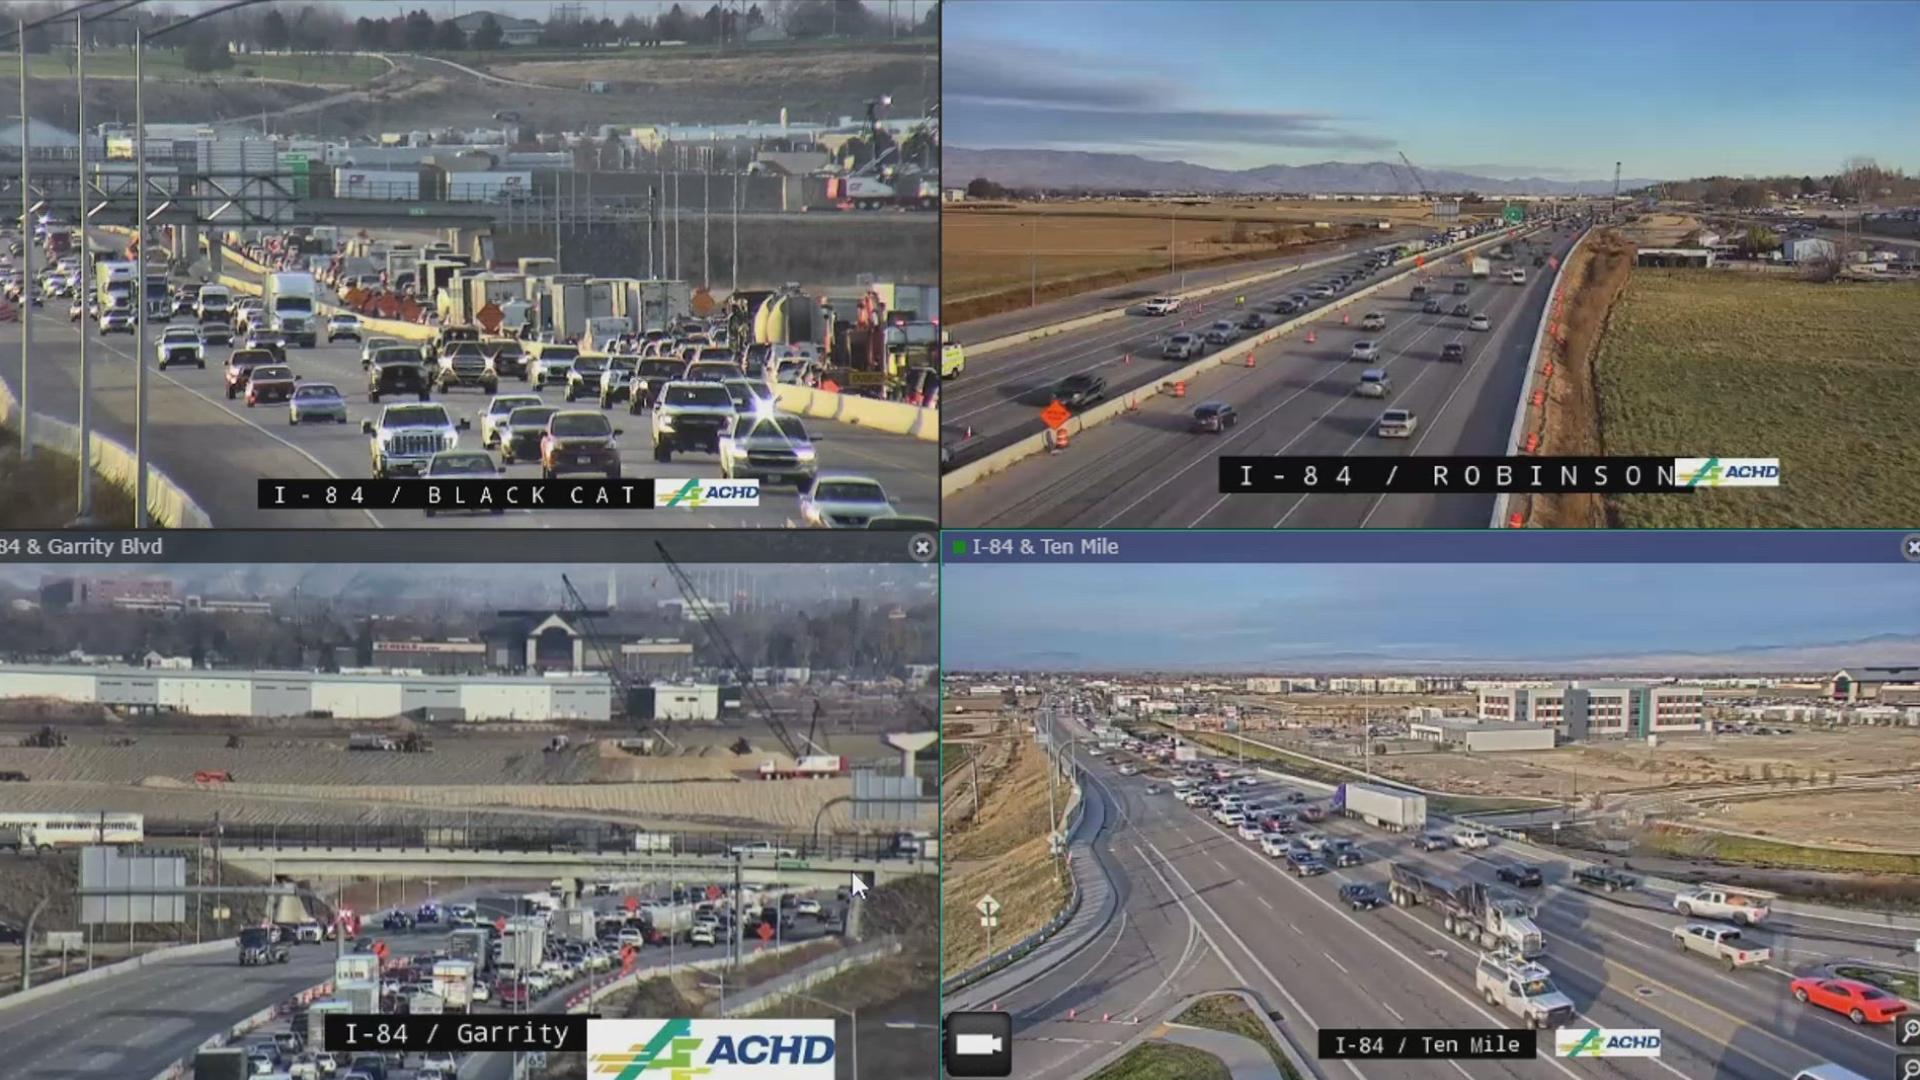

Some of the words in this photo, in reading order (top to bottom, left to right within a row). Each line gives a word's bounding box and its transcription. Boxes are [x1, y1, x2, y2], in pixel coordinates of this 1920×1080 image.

[26, 538, 43, 555] &
[47, 537, 115, 559] Garrity
[121, 537, 163, 555] Blvd
[973, 538, 1014, 555] I-84
[1019, 538, 1036, 555] &
[1039, 538, 1074, 555] Ten
[1081, 536, 1119, 555] Mile
[528, 1055, 545, 1066] 65
